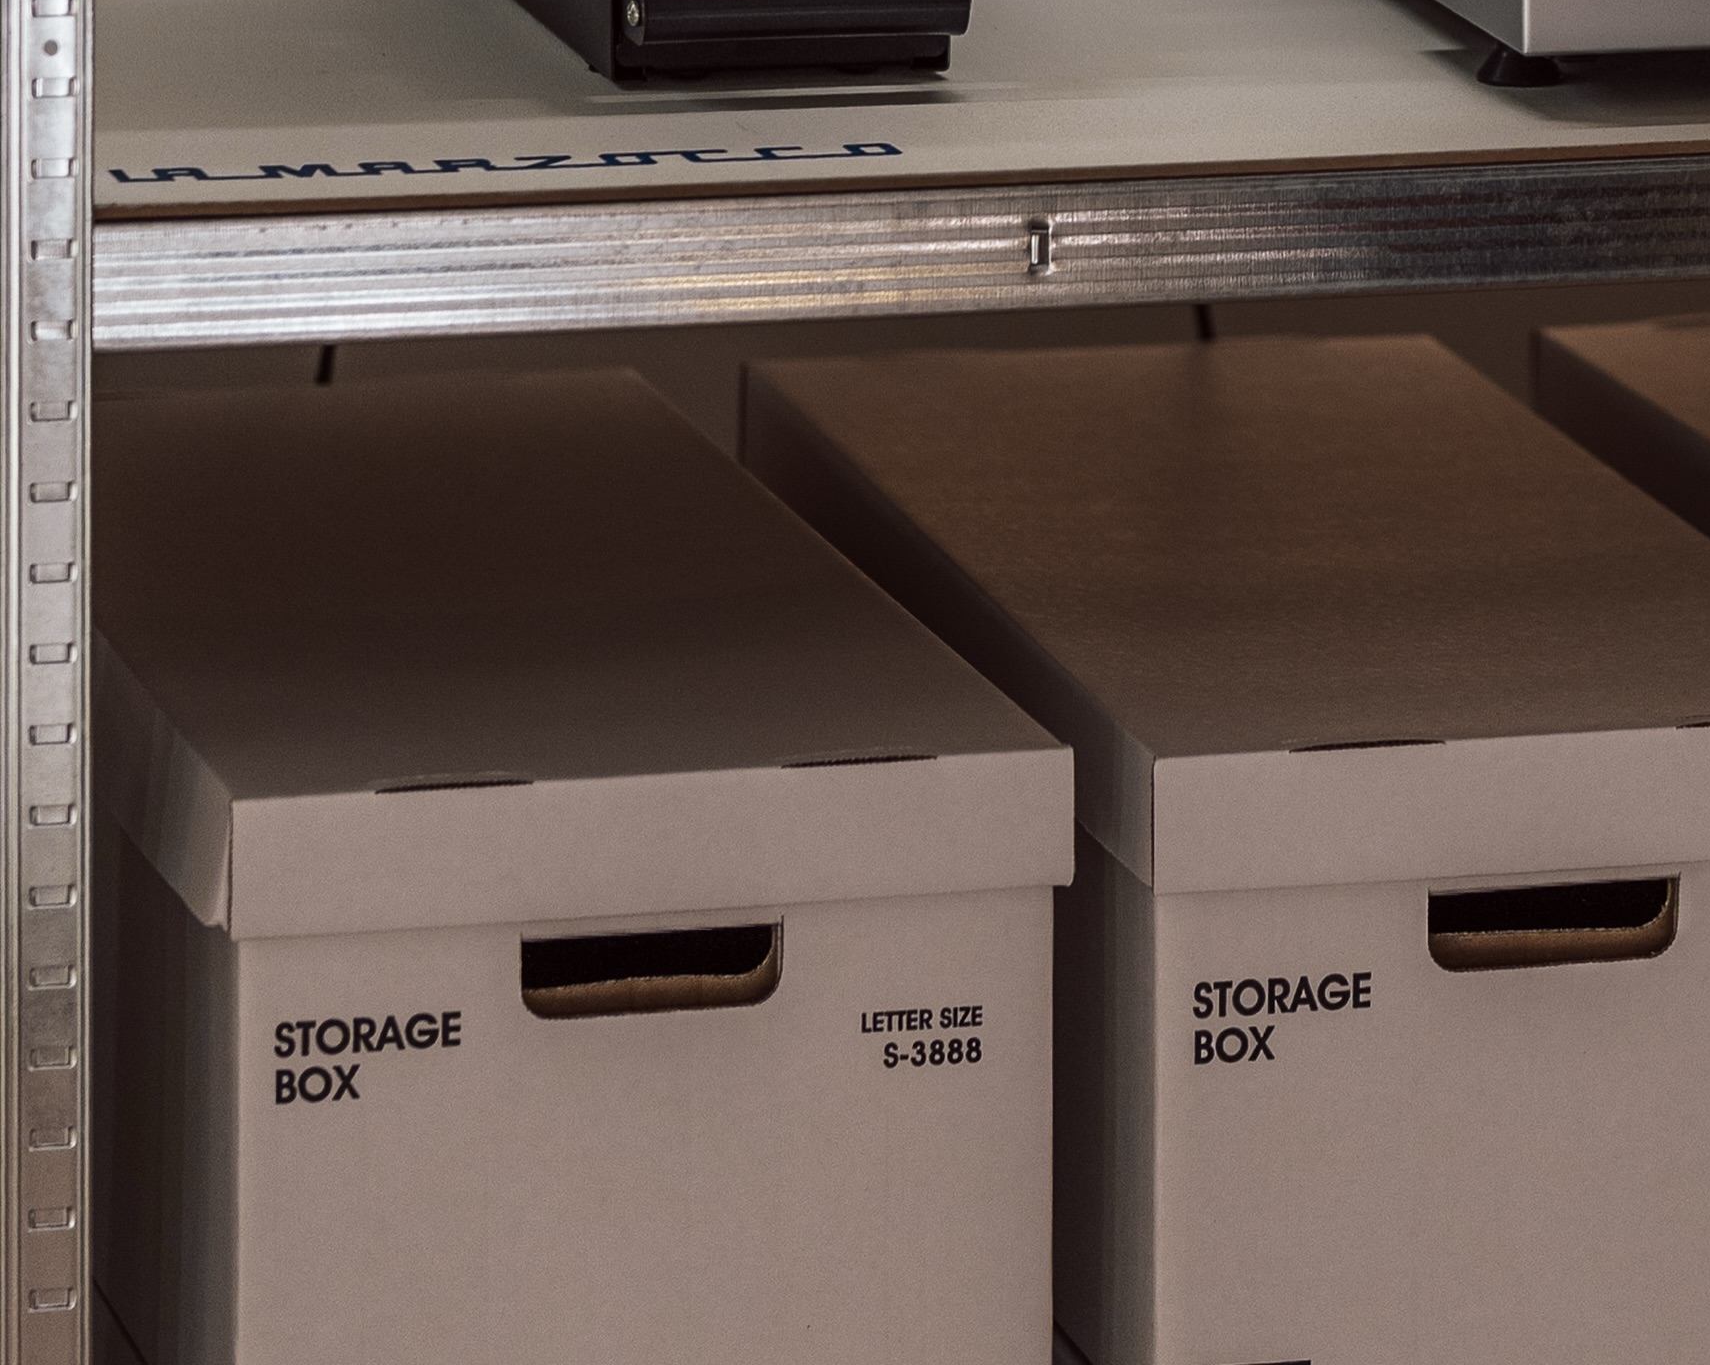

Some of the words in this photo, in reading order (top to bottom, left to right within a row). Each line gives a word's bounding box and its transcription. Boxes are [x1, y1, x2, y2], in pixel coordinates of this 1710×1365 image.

[108, 167, 207, 183] LA
[259, 143, 903, 178] MARZOCCO
[1193, 972, 1371, 1019] STORAGE
[274, 1011, 461, 1058] STORAGE
[862, 1009, 933, 1033] LETTER
[940, 1006, 982, 1029] SIZE
[884, 1037, 981, 1068] S-3888
[1194, 1026, 1274, 1065] BOX
[276, 1064, 360, 1104] BOX
